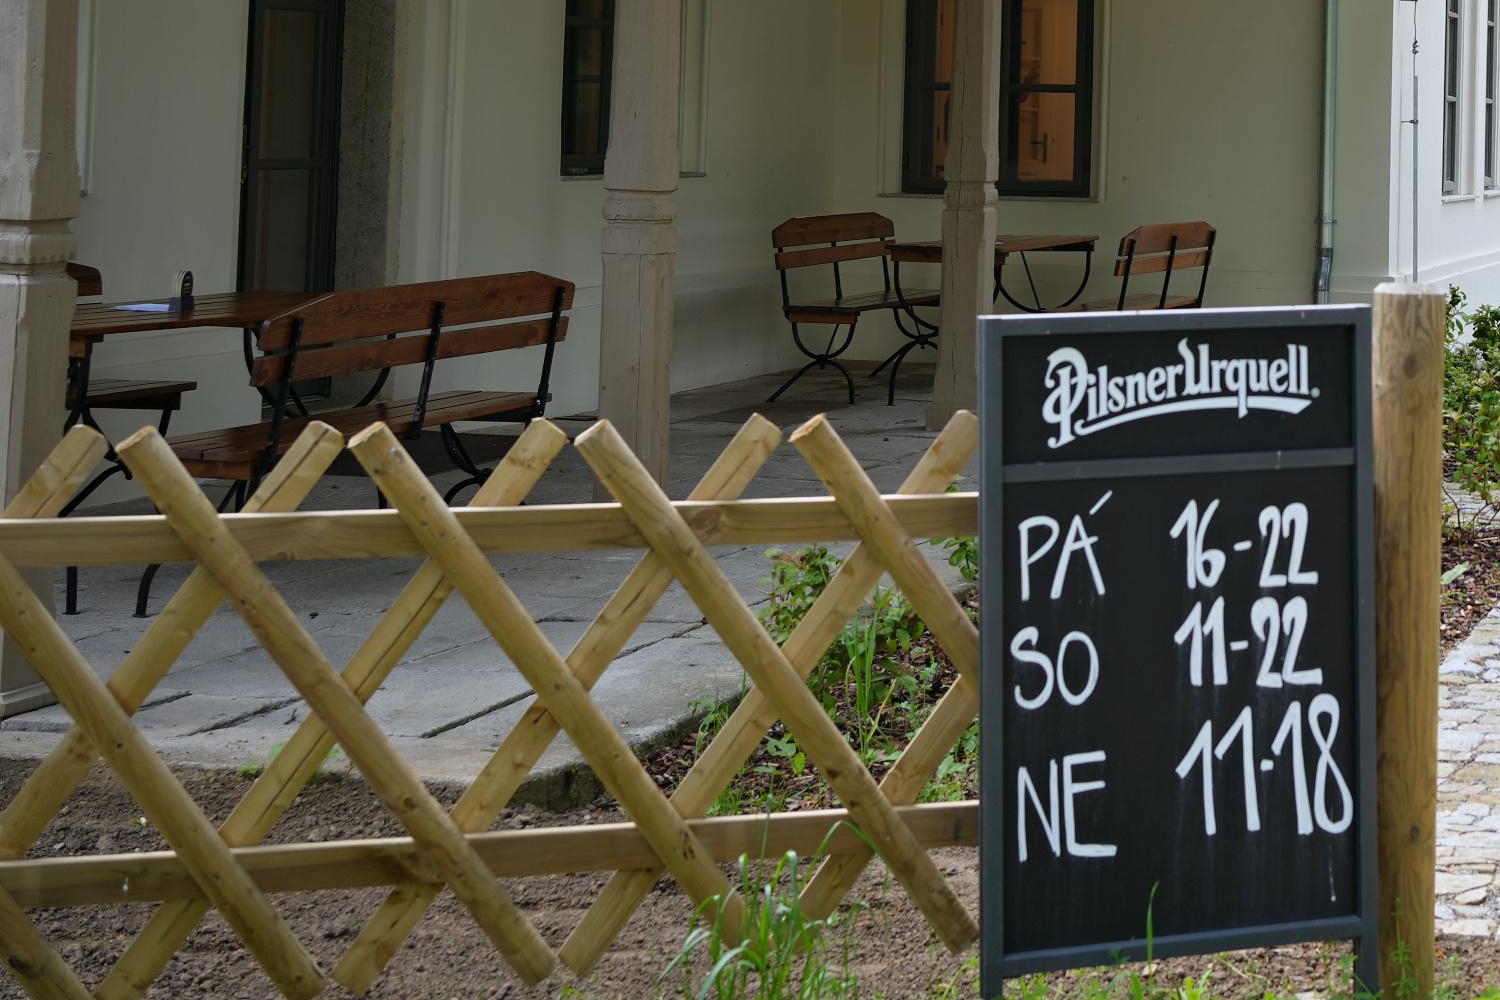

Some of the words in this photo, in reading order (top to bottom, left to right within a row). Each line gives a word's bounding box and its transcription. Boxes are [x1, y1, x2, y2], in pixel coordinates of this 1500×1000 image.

[1042, 347, 1185, 449] Pilsner
[1177, 338, 1311, 419] Urquell
[1018, 490, 1113, 602] PÁ
[1169, 498, 1319, 590] 16-22
[1010, 626, 1100, 710] SO
[1173, 595, 1324, 689] 11-22
[1017, 750, 1118, 863] NE
[1175, 693, 1354, 836] 11-18
